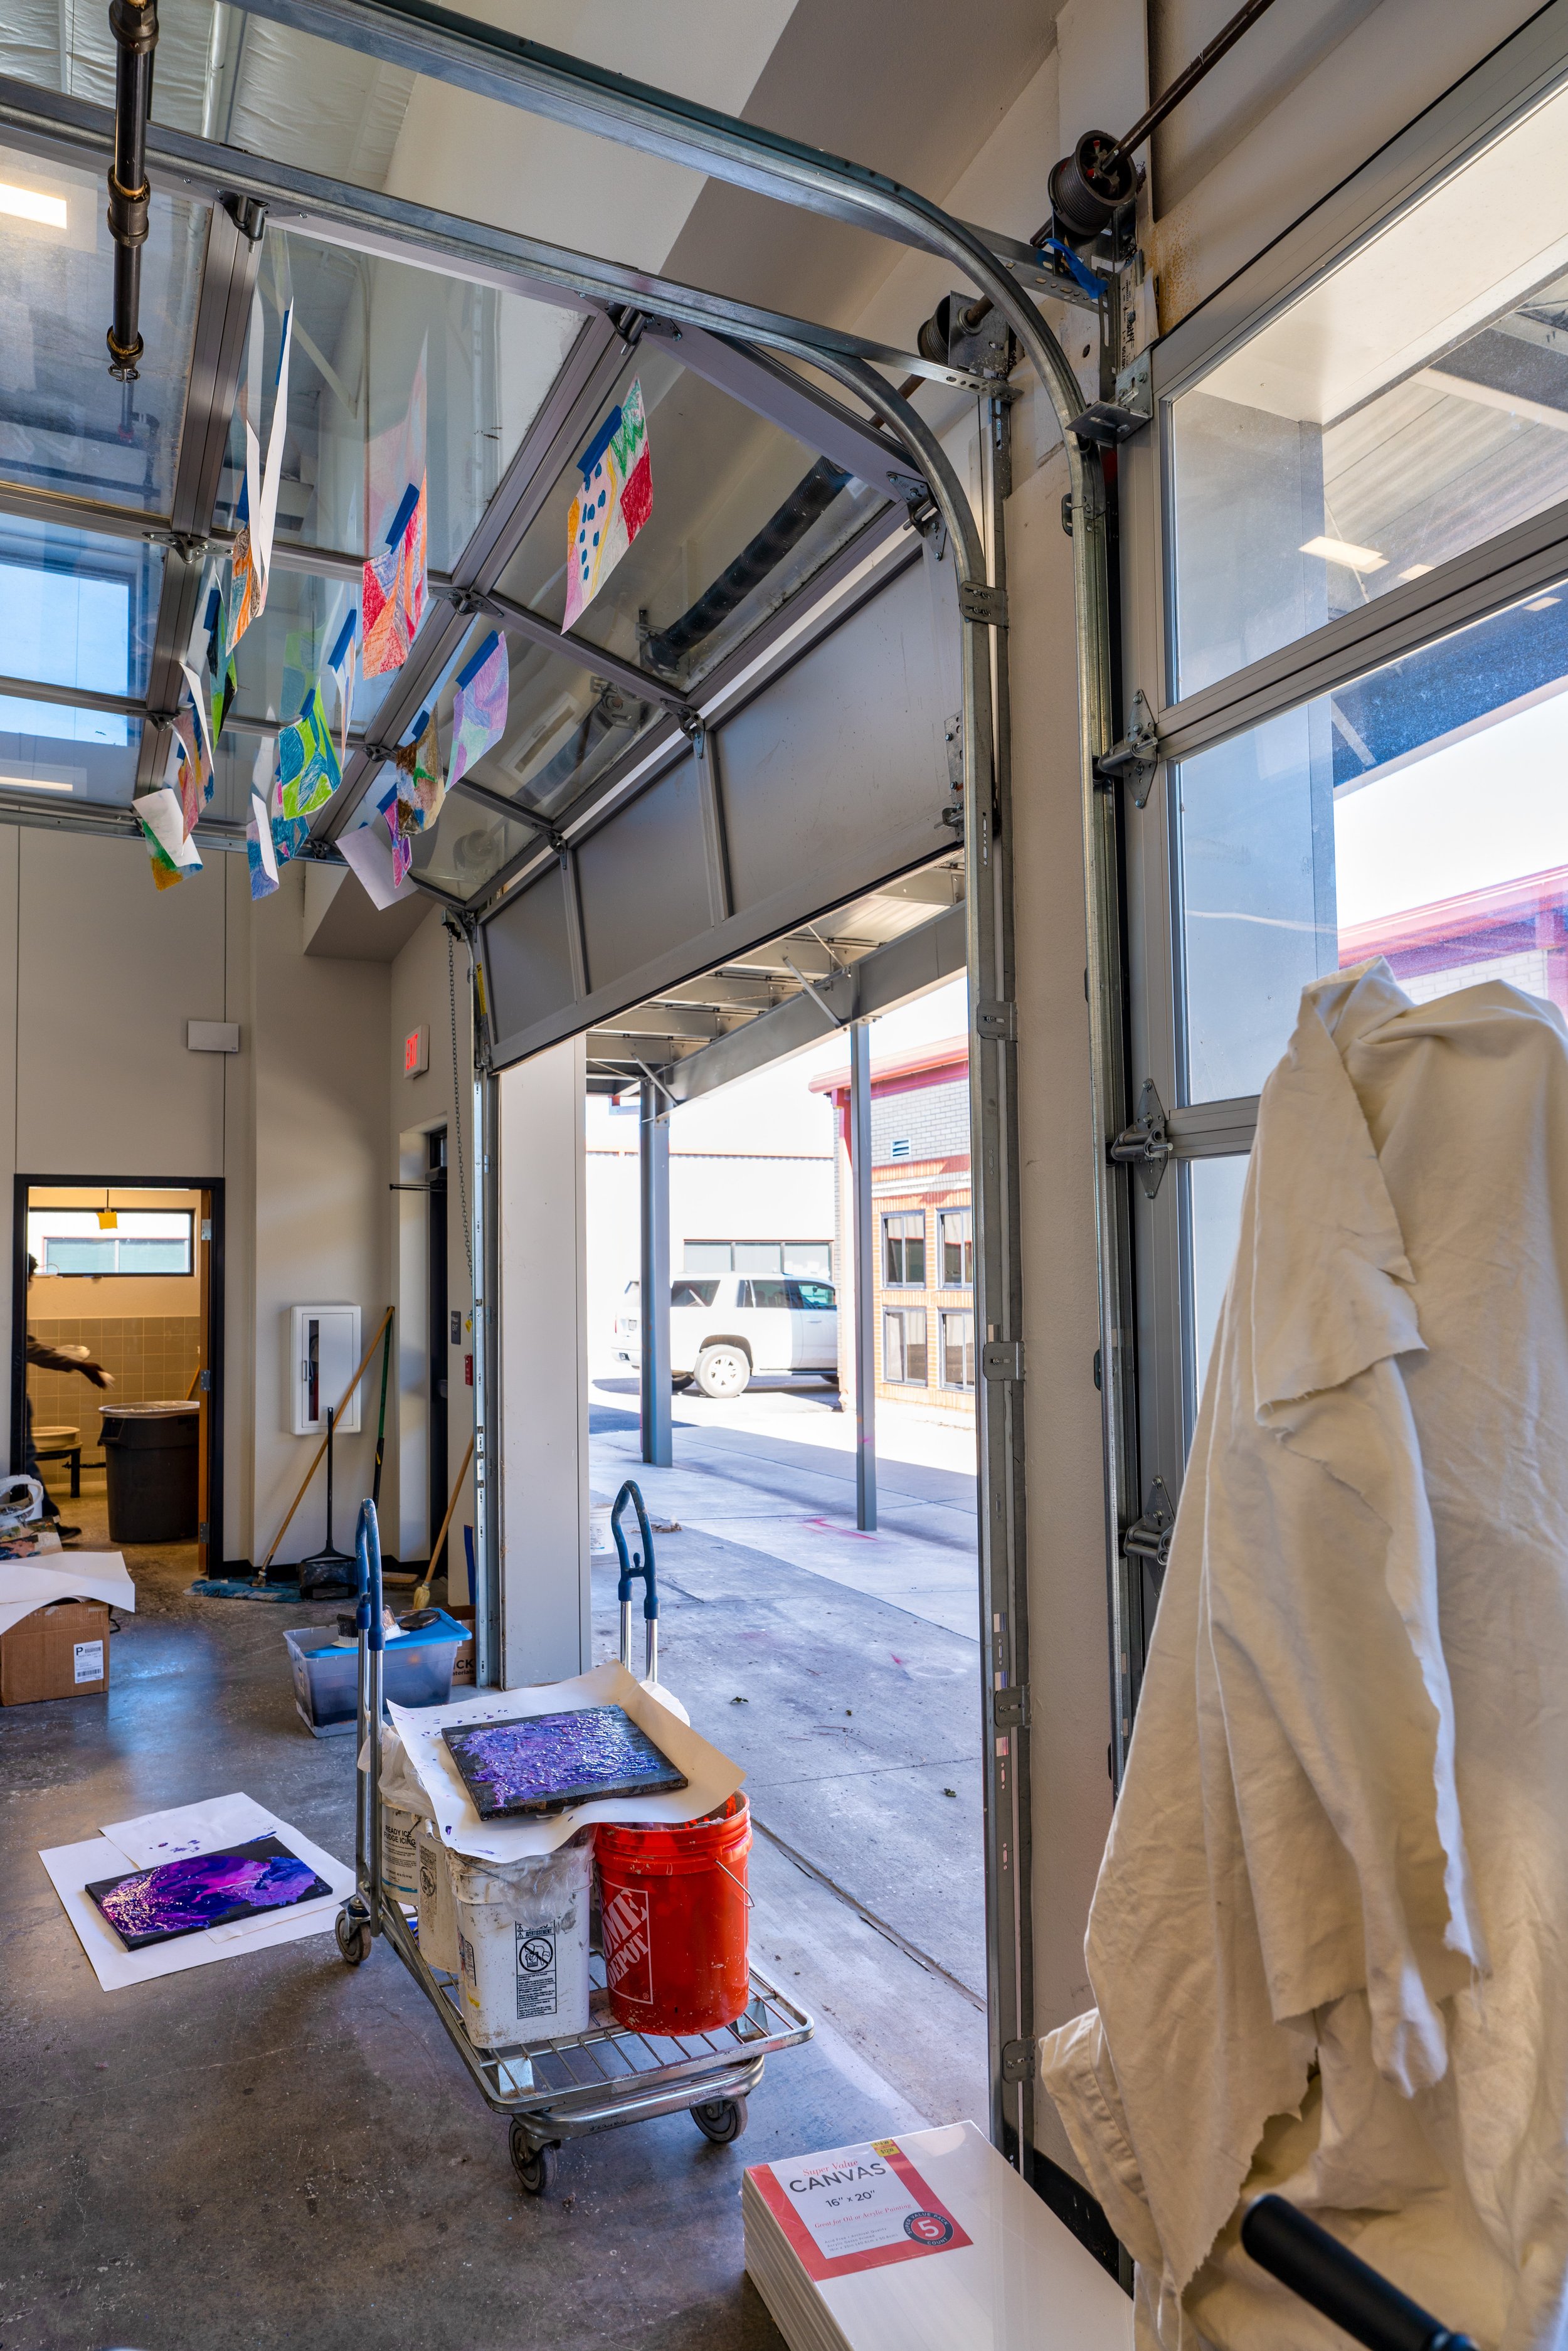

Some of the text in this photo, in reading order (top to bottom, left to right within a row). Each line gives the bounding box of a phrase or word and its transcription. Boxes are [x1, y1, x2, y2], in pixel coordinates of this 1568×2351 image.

[406, 1033, 418, 1070] EXIT
[76, 1647, 83, 1656] P
[384, 1832, 399, 1843] FUDGE
[385, 1825, 401, 1836] READY
[526, 1928, 552, 1937] AVERTISSEMENT
[601, 1888, 647, 1960] OME
[607, 1931, 649, 1989] DEPOT
[803, 2160, 859, 2177] Super Value
[789, 2163, 886, 2193] CANVAS
[815, 2219, 832, 2228] Great
[862, 2210, 884, 2219] Acrylic
[885, 2204, 912, 2213] Painting
[933, 2214, 949, 2226] PACK
[918, 2219, 939, 2237] 5
[927, 2237, 948, 2245] COUNT
